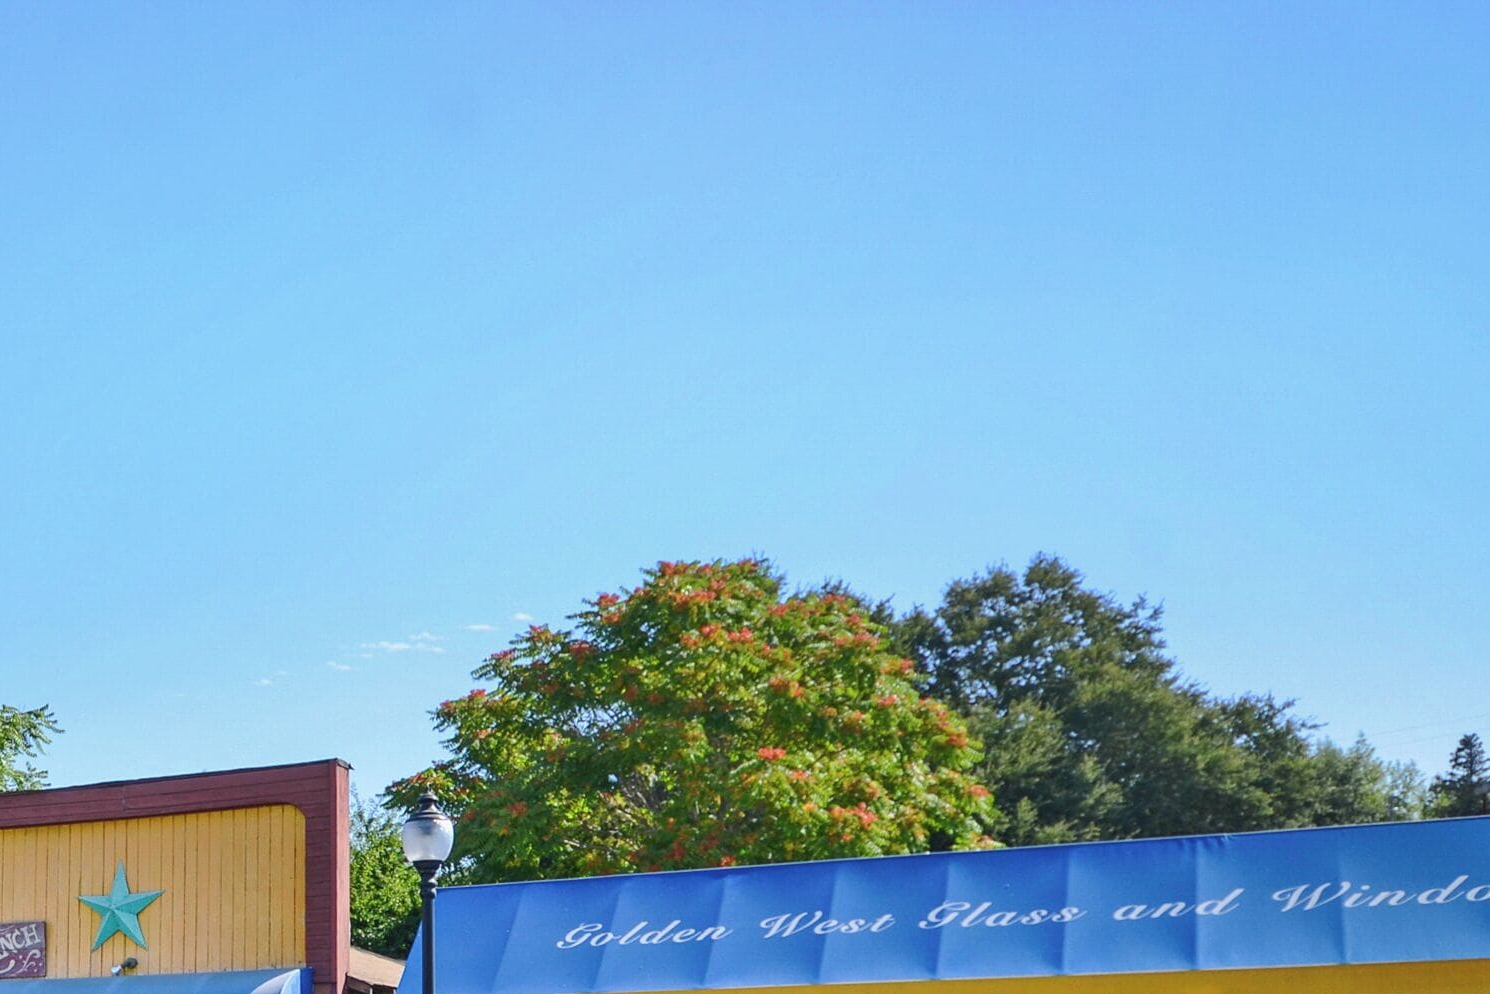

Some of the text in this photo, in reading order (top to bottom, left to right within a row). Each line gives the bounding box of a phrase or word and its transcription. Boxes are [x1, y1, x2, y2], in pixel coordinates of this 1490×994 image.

[556, 919, 734, 950] Golden
[759, 910, 896, 940] West
[917, 898, 1087, 931] Glass
[1112, 888, 1246, 923] and
